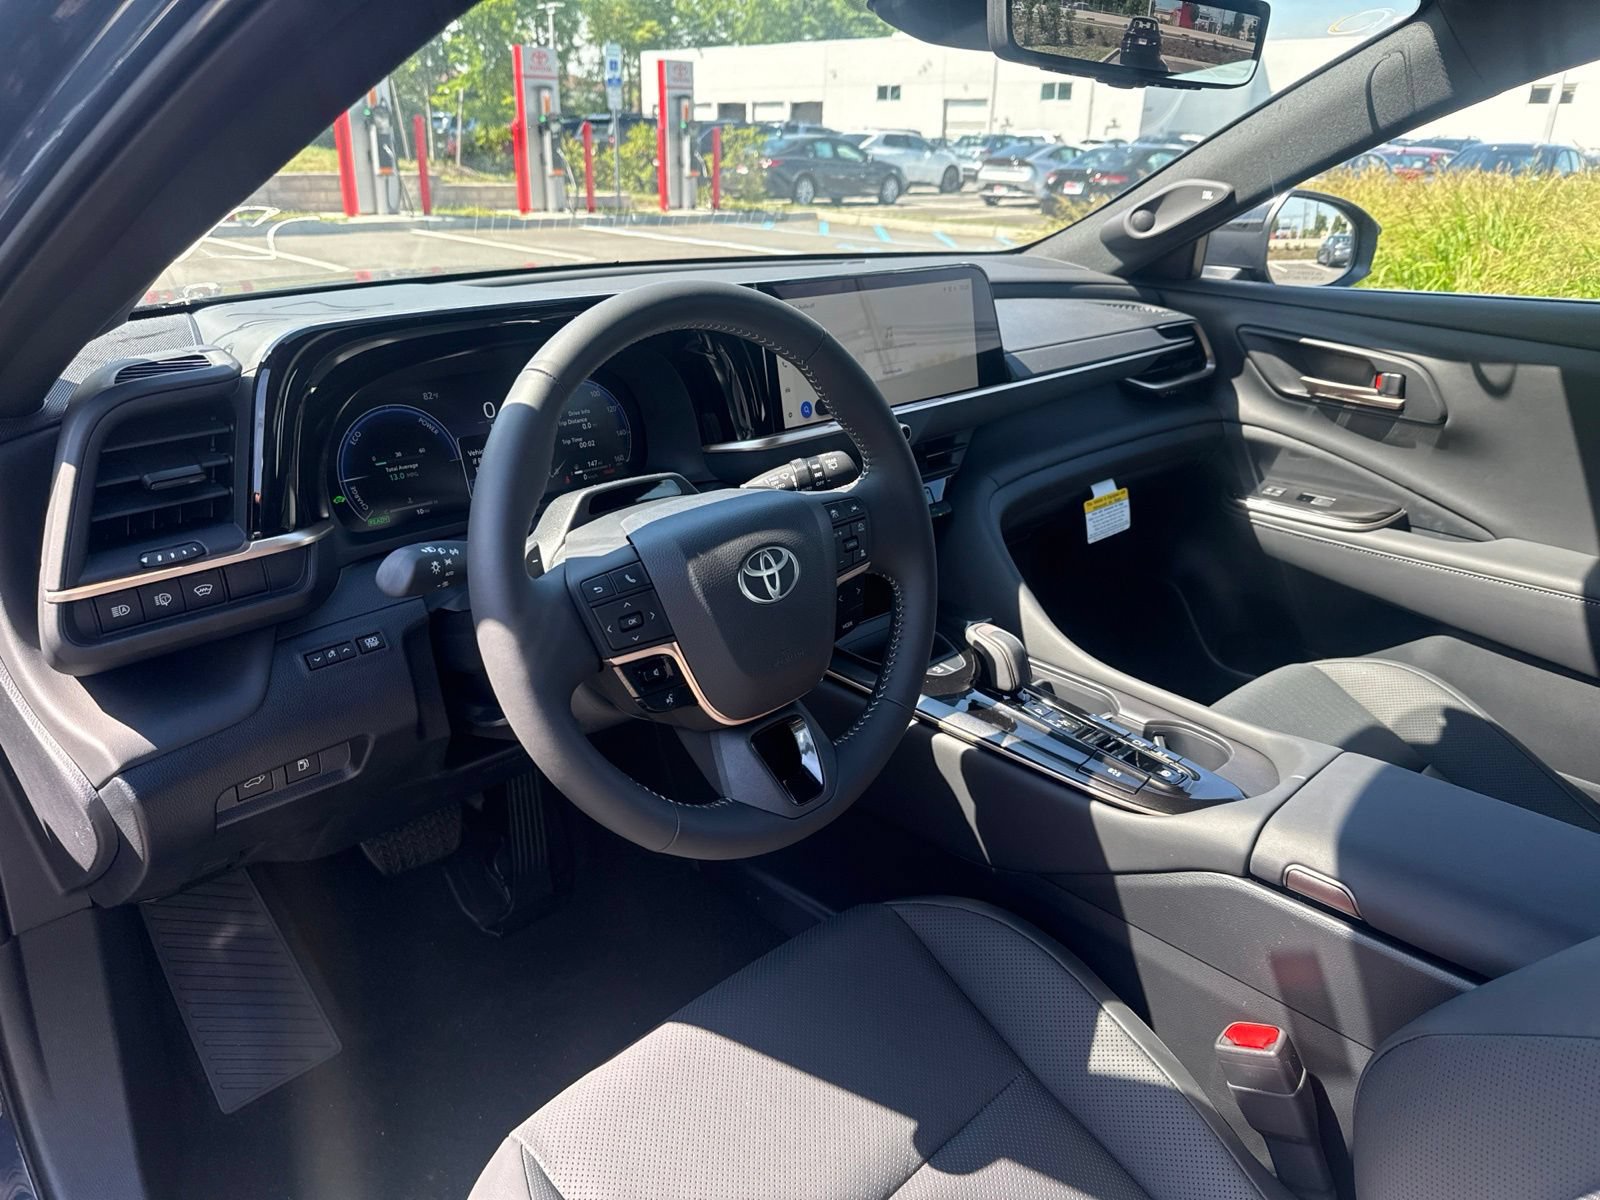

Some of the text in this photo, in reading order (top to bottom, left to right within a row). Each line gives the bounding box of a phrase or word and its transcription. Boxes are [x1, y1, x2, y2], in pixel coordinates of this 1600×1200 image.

[483, 401, 496, 419] 0
[418, 417, 439, 435] POWER
[350, 431, 362, 445] ECO
[385, 463, 419, 473] Total Average
